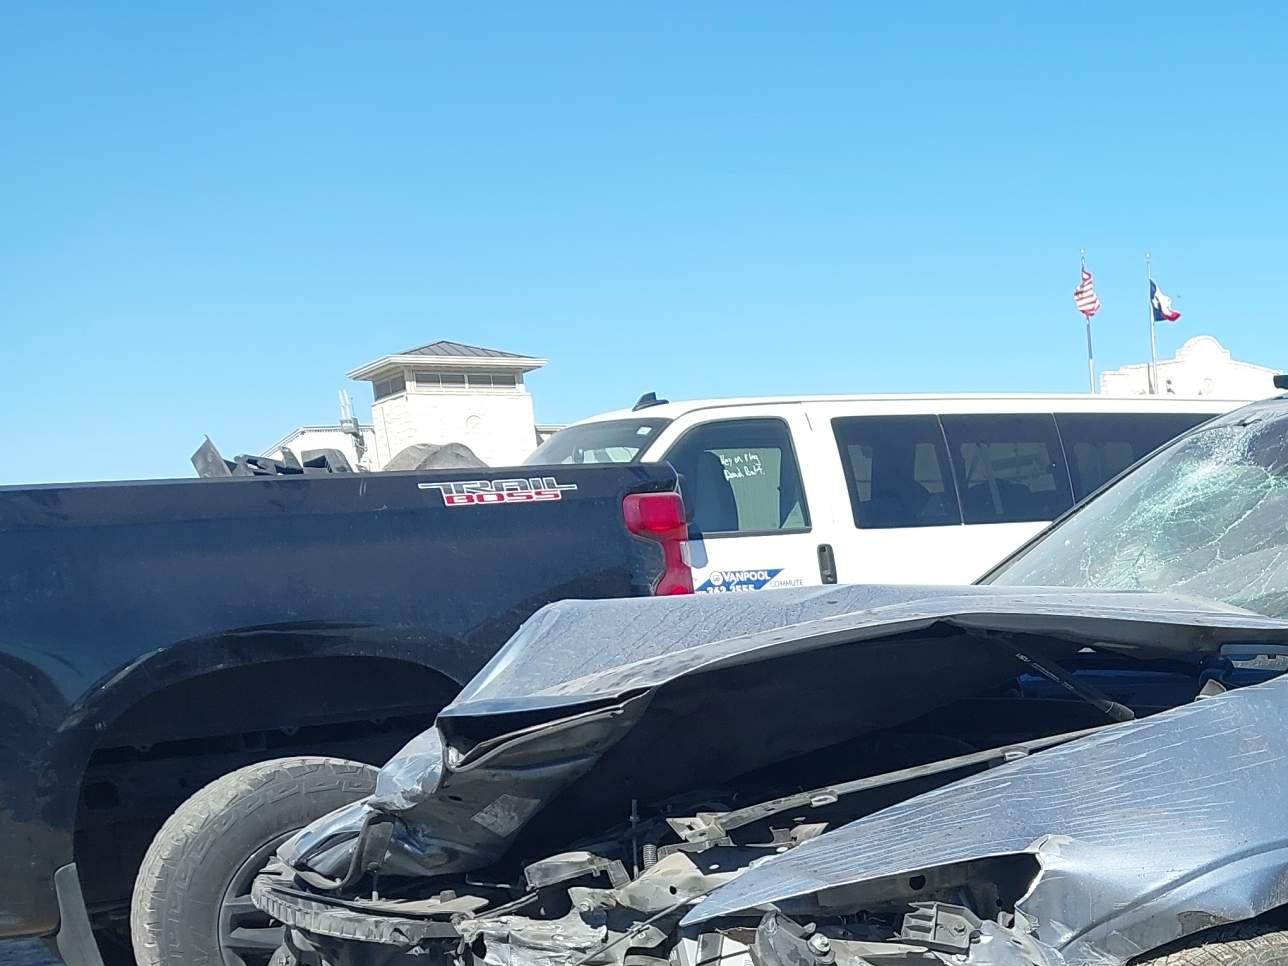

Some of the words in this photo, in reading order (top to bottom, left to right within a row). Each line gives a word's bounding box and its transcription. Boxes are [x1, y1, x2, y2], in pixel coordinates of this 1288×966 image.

[418, 477, 578, 494] TRAIL
[445, 490, 561, 506] BOSS
[722, 571, 771, 582] VANPOOL
[769, 579, 803, 588] COMMUTE
